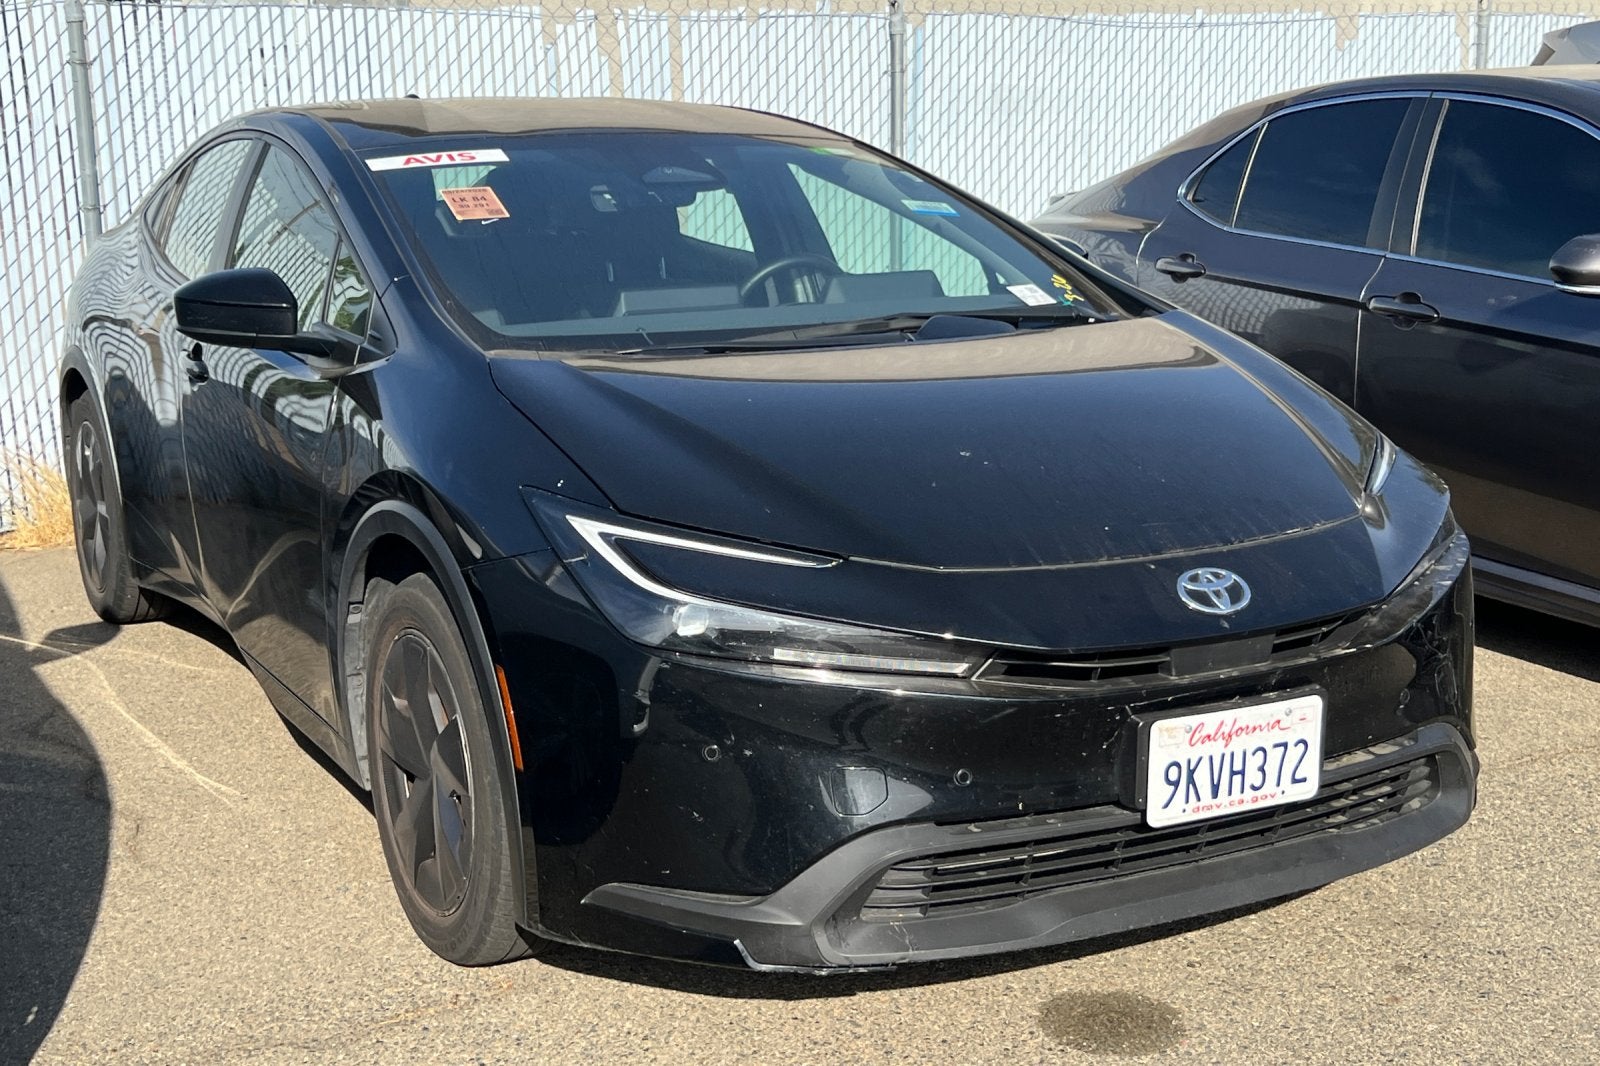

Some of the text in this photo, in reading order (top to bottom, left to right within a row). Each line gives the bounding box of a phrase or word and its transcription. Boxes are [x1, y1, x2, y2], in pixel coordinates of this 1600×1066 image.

[403, 152, 477, 166] AVIS
[1188, 718, 1291, 748] California
[1161, 738, 1309, 810] 9KVH372
[1191, 792, 1277, 814] dmv.ca.gov
